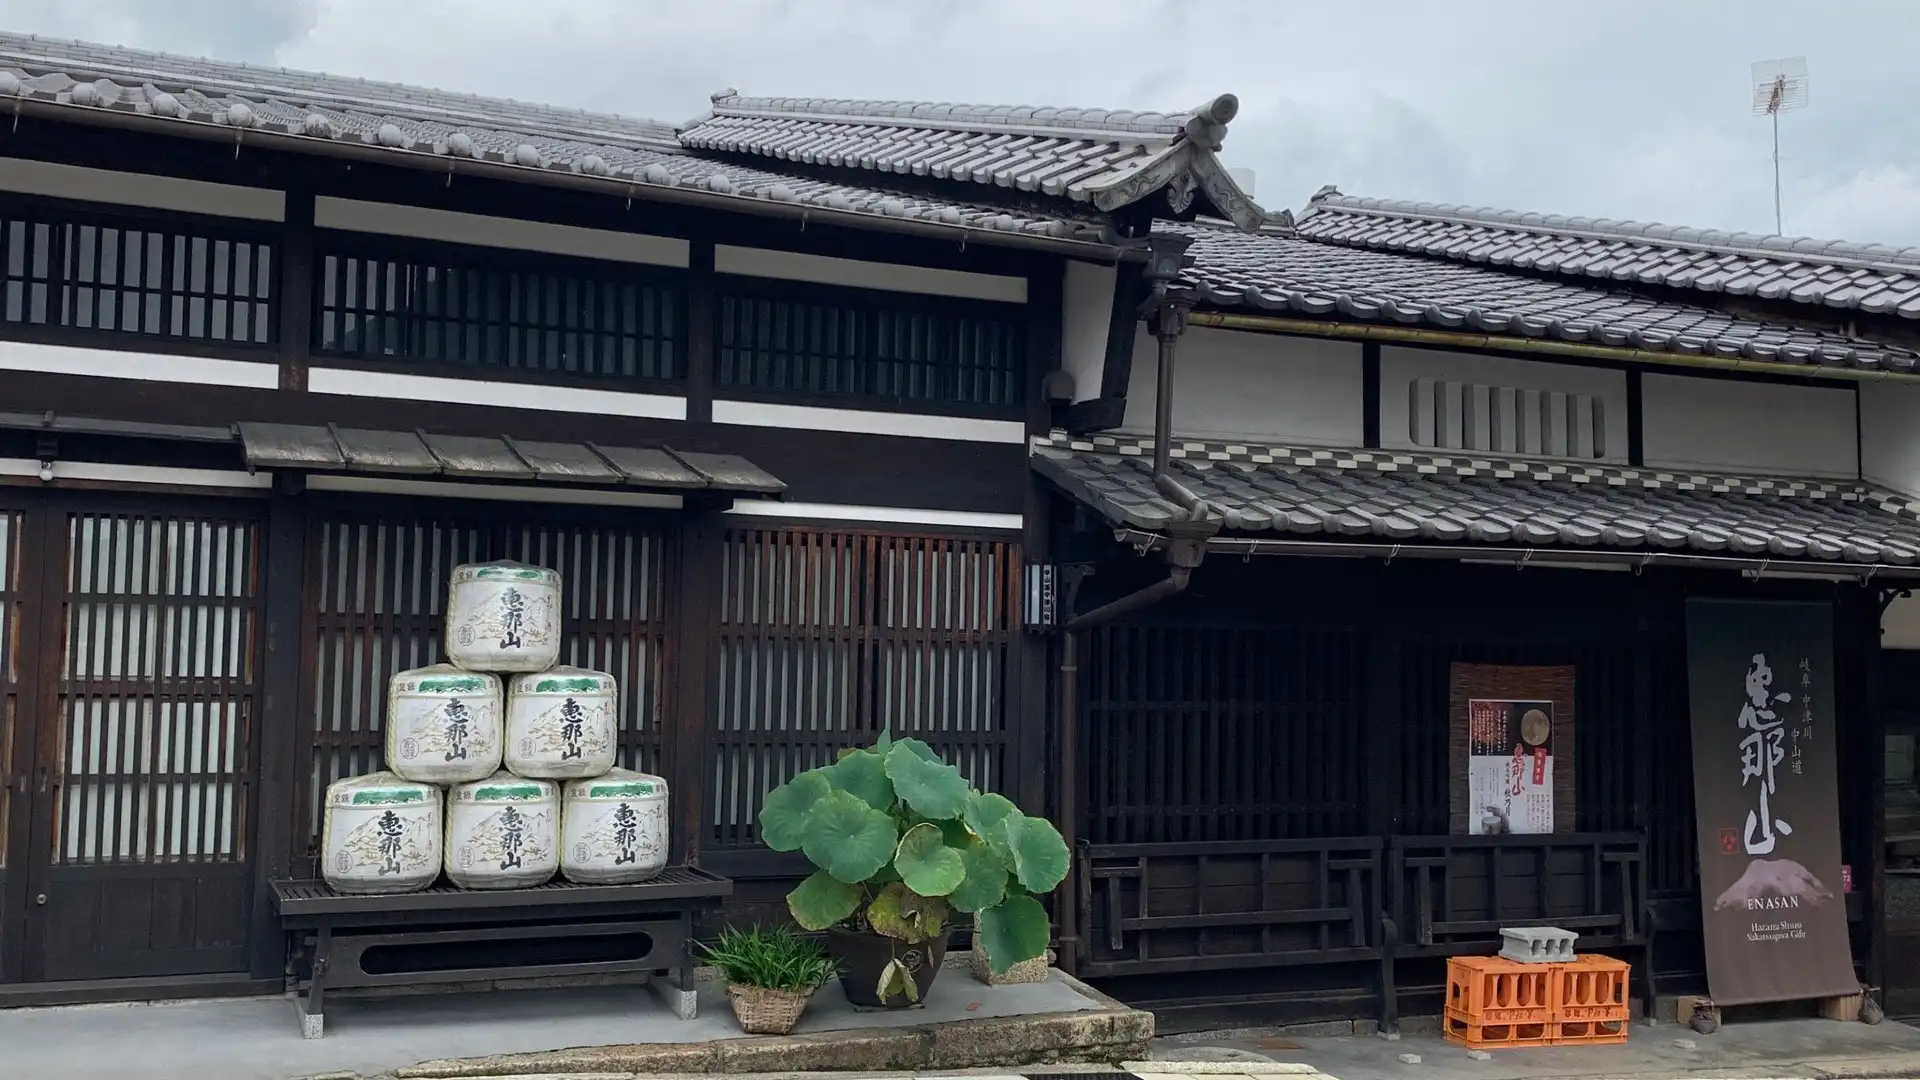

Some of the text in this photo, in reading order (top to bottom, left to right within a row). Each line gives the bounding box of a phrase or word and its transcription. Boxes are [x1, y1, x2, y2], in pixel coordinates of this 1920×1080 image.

[500, 586, 524, 649] 恵那山
[443, 697, 469, 762] 恵那山
[559, 697, 583, 761] 恵那山
[1799, 657, 1812, 740] 岐阜 中津川
[1738, 653, 1793, 855] 恵那山
[1791, 728, 1804, 775] 中山道
[377, 809, 403, 876] 恵那山
[498, 806, 524, 871] 恵那山
[613, 802, 637, 866] 恵那山
[1748, 896, 1799, 910] ENASAN
